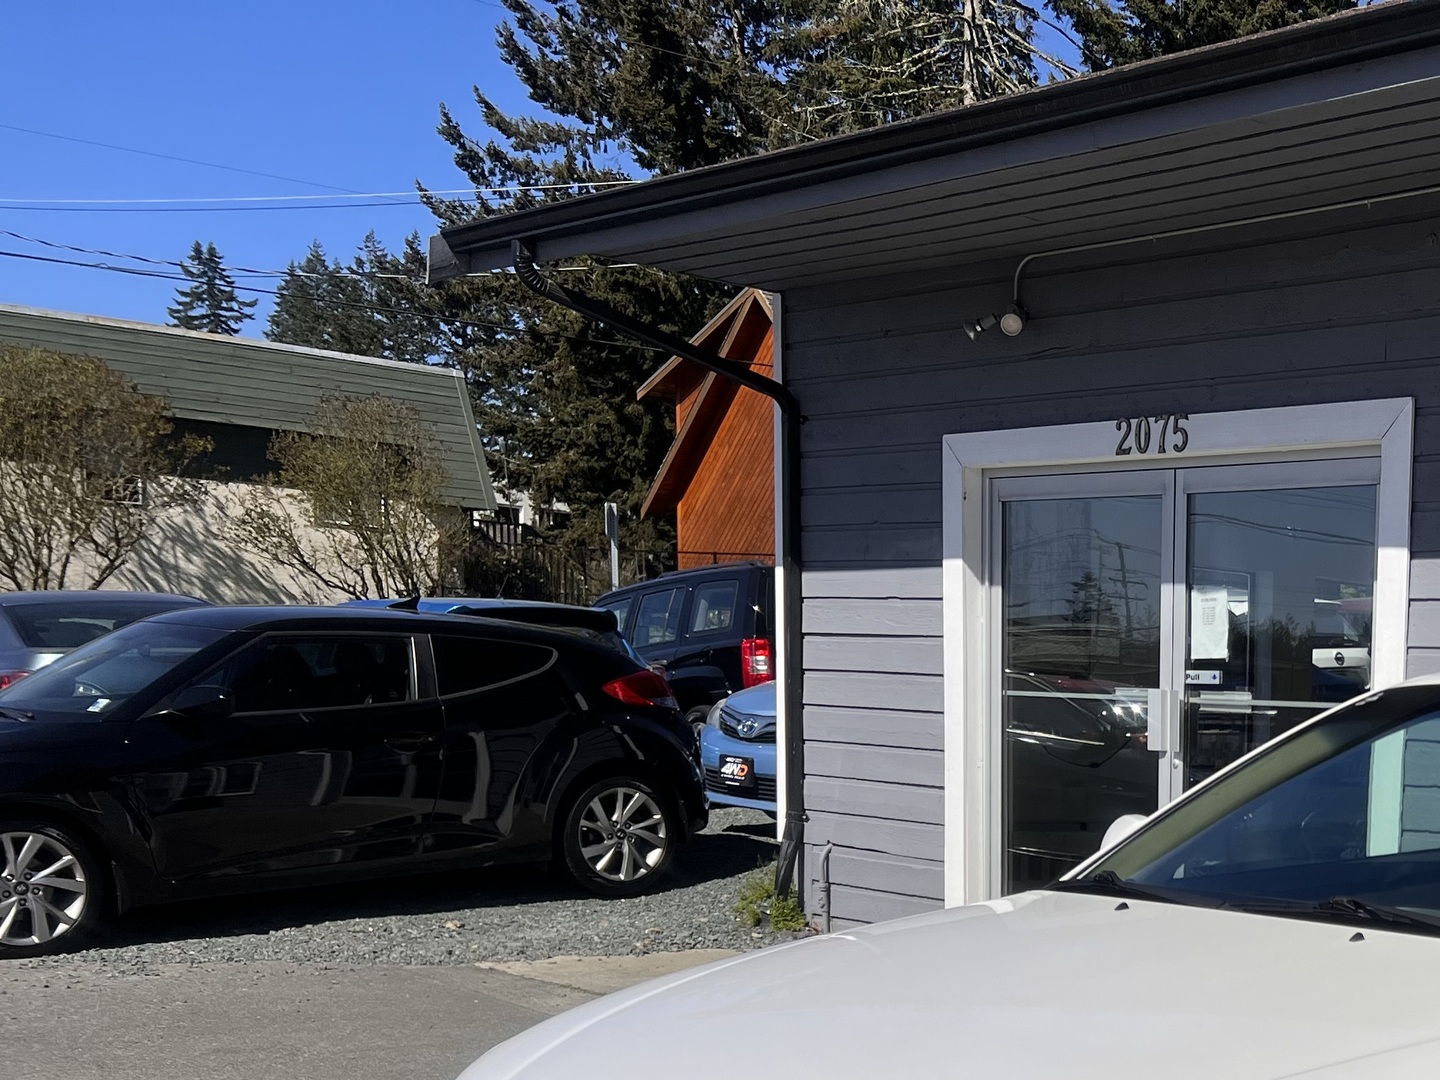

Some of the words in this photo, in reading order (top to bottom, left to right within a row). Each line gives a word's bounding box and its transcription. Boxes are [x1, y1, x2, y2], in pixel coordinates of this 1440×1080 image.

[1115, 413, 1189, 455] 2075
[1185, 673, 1200, 681] Pull
[720, 762, 749, 777] 4WD
